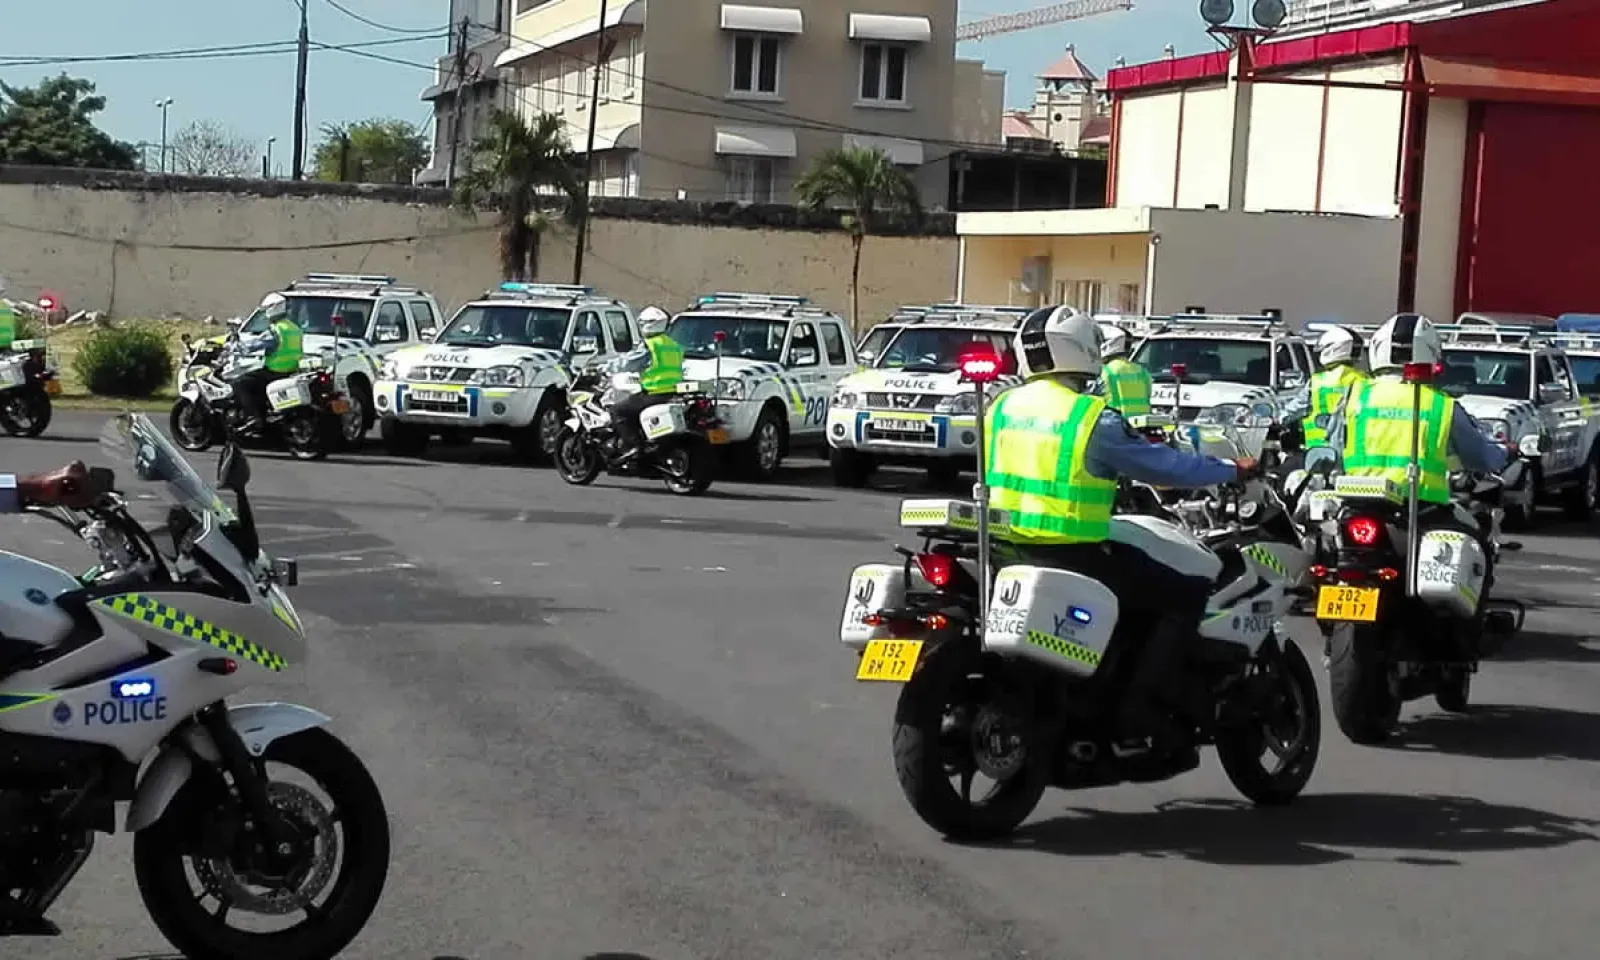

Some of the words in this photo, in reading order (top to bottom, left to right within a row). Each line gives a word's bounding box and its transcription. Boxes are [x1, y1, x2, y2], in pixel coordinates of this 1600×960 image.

[424, 353, 470, 363] POLICE
[884, 379, 938, 390] POLICE
[1420, 570, 1459, 585] POLICE
[1338, 589, 1361, 602] 202
[1353, 603, 1366, 617] 17
[986, 619, 1025, 635] POLICE
[882, 643, 903, 658] 192
[891, 660, 906, 675] 17
[84, 696, 167, 725] POLICE
